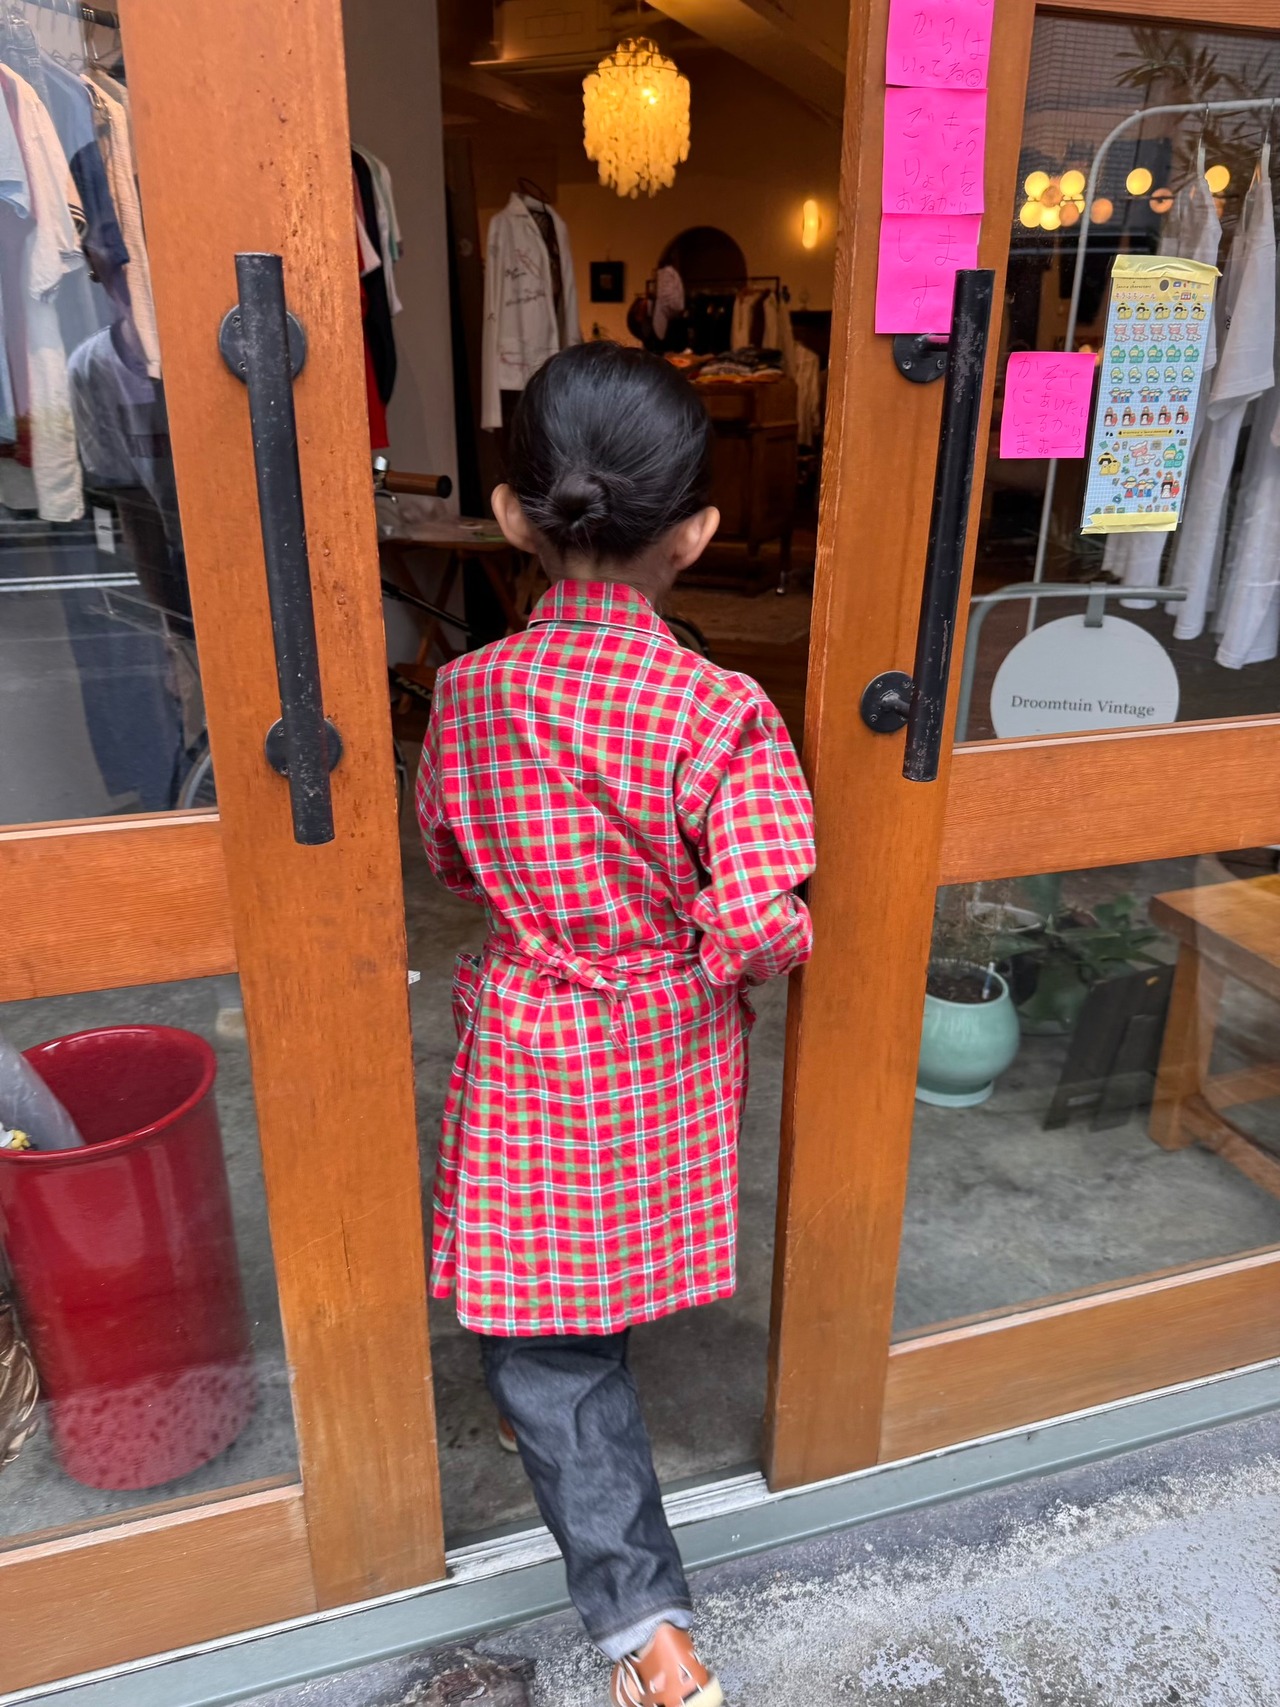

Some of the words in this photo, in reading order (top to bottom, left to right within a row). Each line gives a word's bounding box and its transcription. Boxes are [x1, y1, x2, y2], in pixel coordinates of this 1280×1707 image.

[903, 159, 977, 197] りょくを
[895, 187, 968, 214] おねがい
[897, 224, 960, 267] しま
[911, 274, 942, 321] す
[1018, 357, 1080, 391] かぞく
[1011, 695, 1092, 712] Droomtuin
[1097, 700, 1155, 719] Vintage
